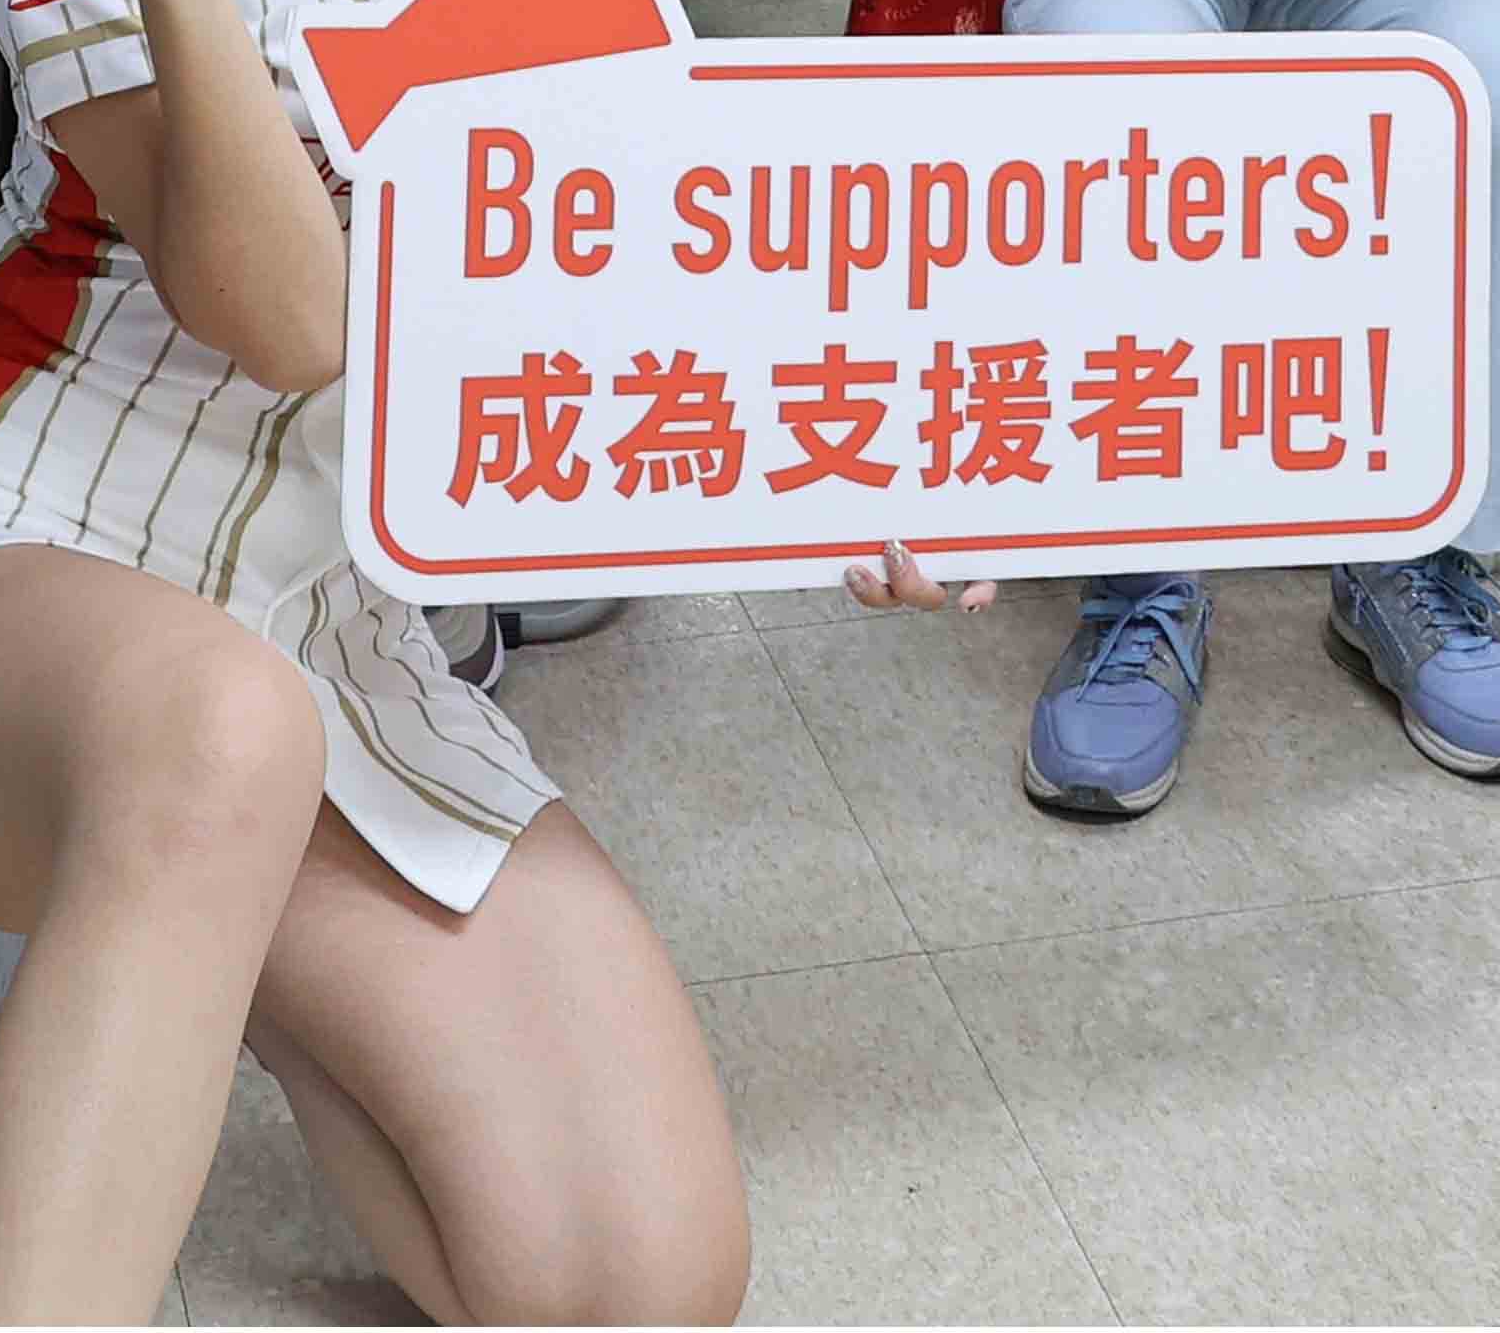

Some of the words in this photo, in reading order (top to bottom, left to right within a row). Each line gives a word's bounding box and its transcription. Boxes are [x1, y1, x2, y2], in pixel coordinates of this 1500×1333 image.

[463, 126, 616, 279] Be
[671, 111, 1394, 312] supporters!
[446, 326, 1393, 509] 成為支援者吧!
